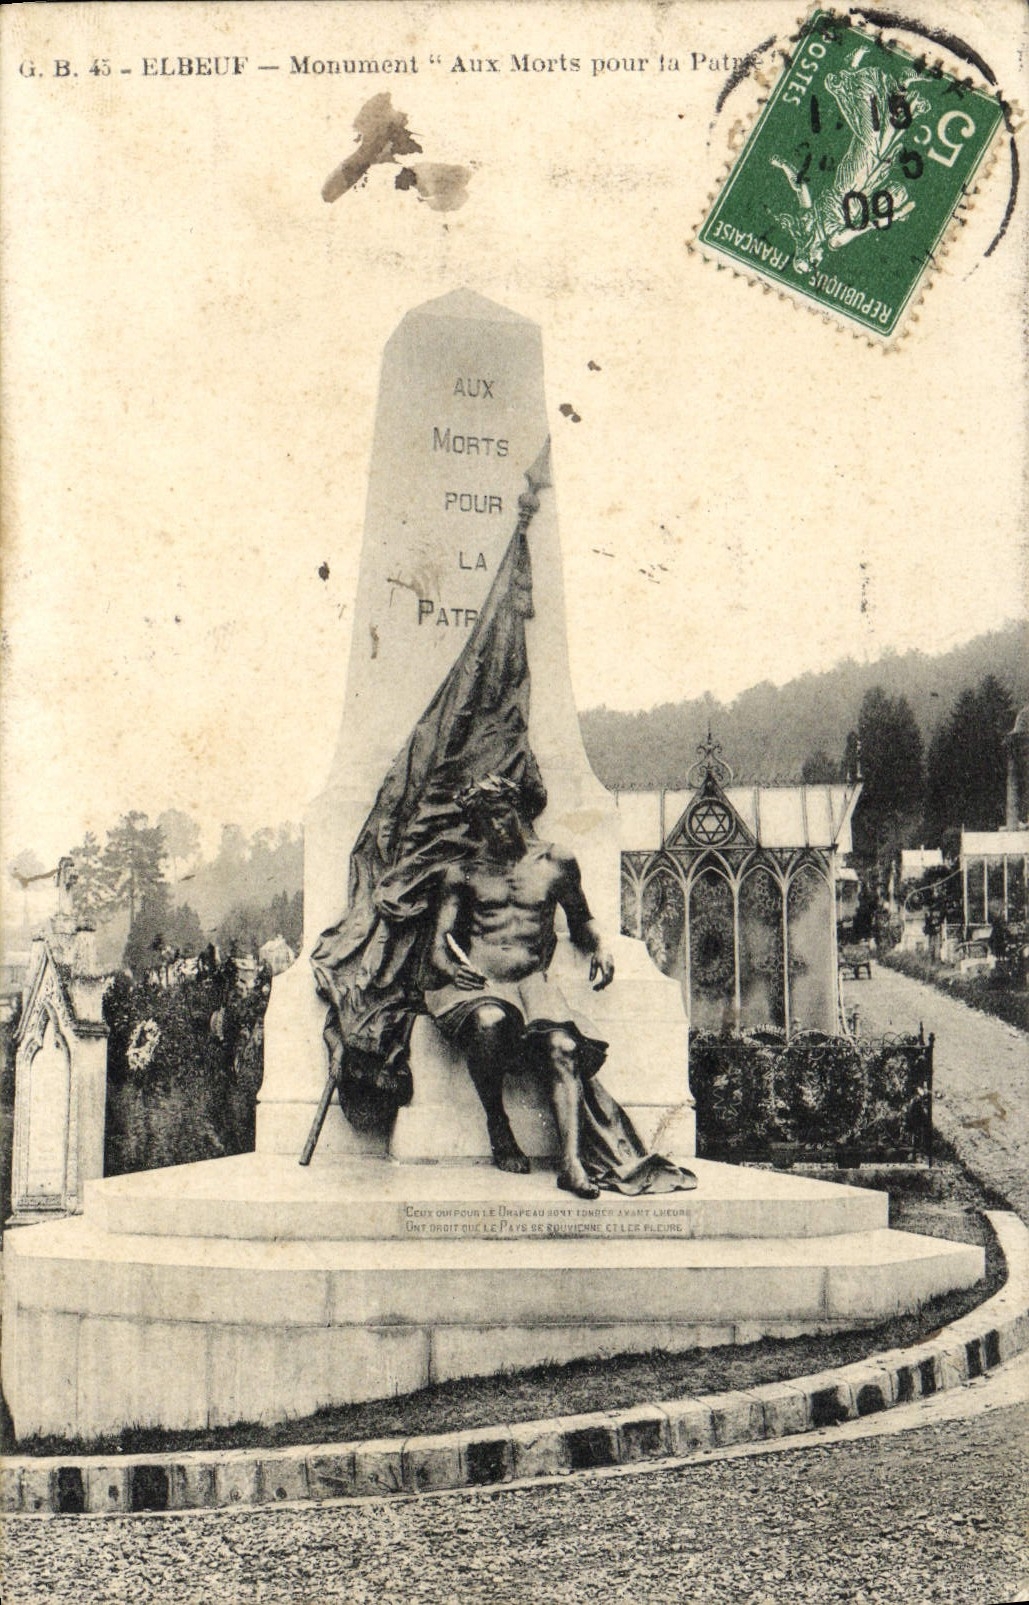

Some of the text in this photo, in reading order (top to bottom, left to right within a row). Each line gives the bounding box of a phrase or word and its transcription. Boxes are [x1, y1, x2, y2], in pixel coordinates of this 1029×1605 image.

[927, 109, 976, 169] 5
[842, 190, 894, 231] 09
[712, 220, 790, 271] FRANÇAISE
[453, 377, 496, 399] AUX
[444, 492, 503, 514] POUR
[459, 551, 488, 572] LA
[417, 599, 480, 627] PATR
